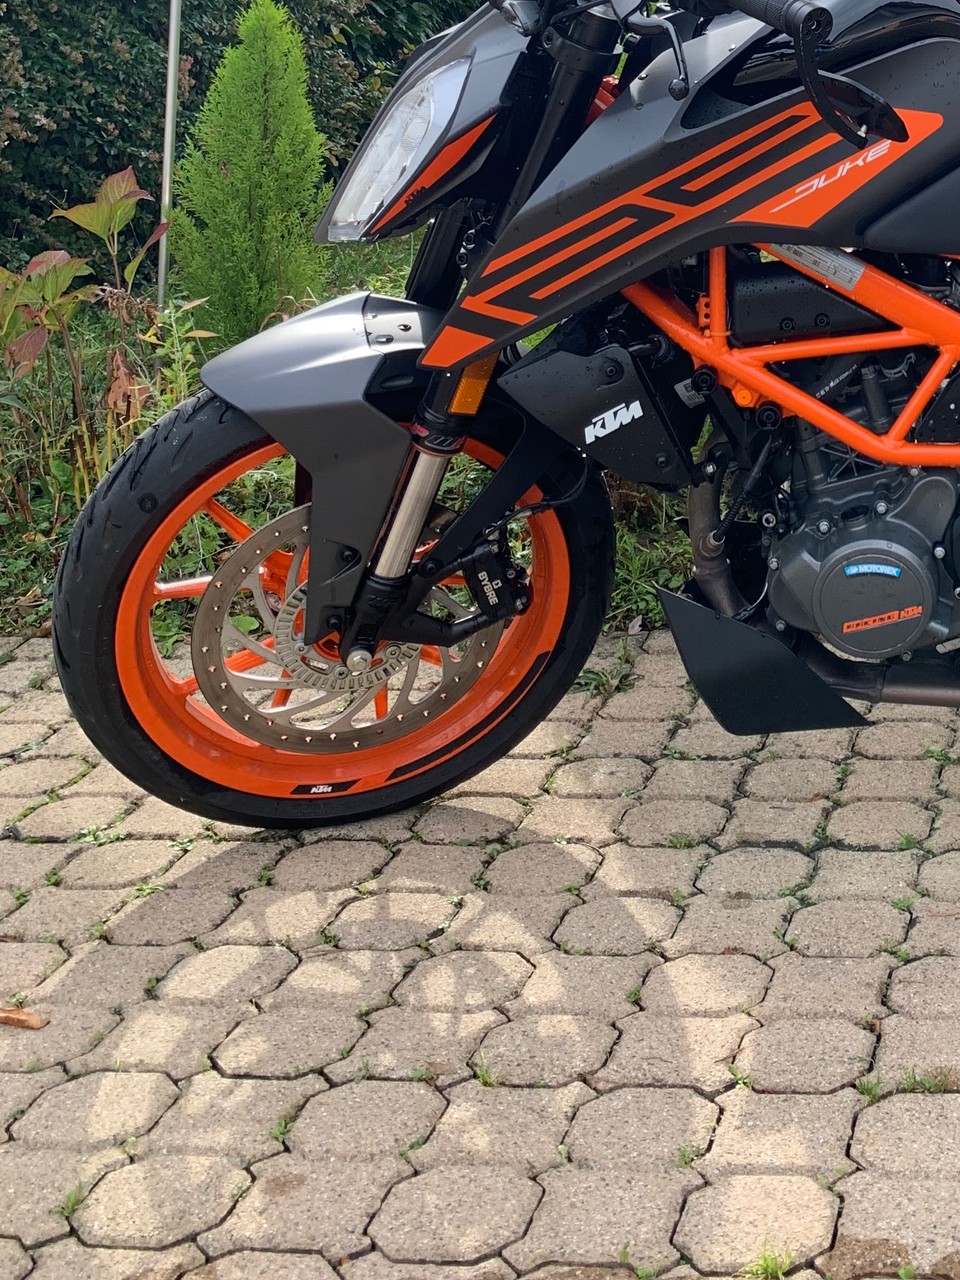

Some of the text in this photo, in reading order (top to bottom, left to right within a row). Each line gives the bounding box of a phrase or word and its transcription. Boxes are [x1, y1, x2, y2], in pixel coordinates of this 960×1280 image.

[768, 139, 892, 213] DUKE
[584, 399, 643, 445] KTM
[858, 563, 897, 577] MOTOREX
[477, 571, 499, 606] BYBRE
[310, 784, 333, 794] KTM
